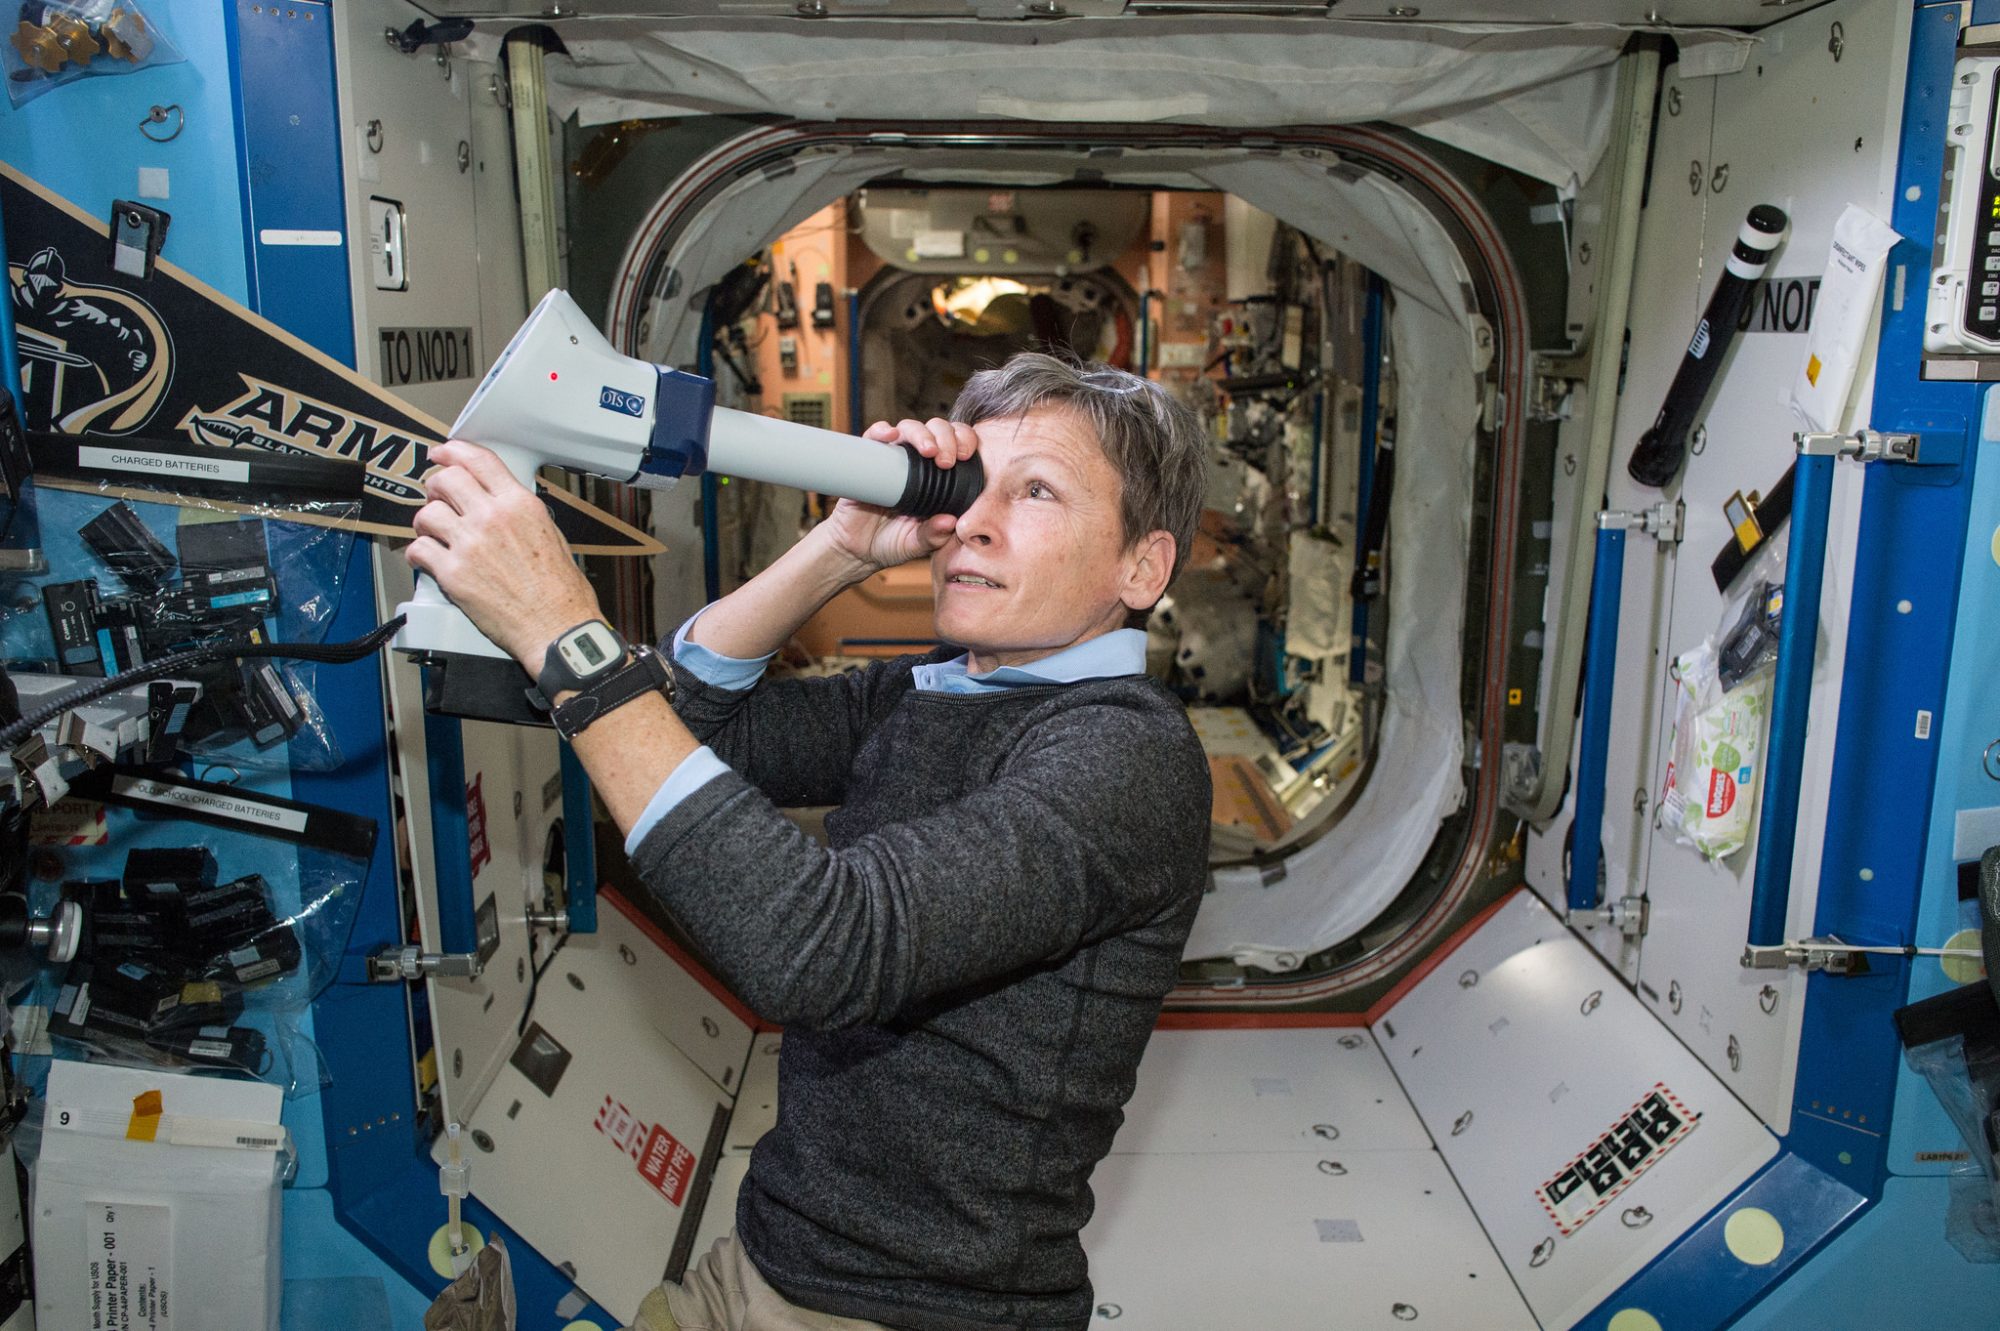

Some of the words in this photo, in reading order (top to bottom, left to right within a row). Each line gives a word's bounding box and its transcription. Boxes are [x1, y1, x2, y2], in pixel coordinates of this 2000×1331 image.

[381, 330, 412, 385] TO
[416, 329, 458, 381] NOD
[462, 331, 471, 378] 1
[226, 385, 440, 481] ARMY
[251, 435, 312, 457] BLAC
[111, 454, 163, 468] CHARGED
[165, 459, 220, 474] BATTERIES
[138, 784, 156, 795] OLD
[156, 787, 193, 803] SCHOOL
[192, 794, 234, 810] CHARGED
[234, 803, 281, 821] BATTERIES
[60, 1111, 70, 1126] 9
[644, 1134, 672, 1178] WATER
[660, 1165, 681, 1200] MIST
[671, 1144, 690, 1172] PFE
[105, 1210, 116, 1223] Qty
[103, 1231, 116, 1250] 001
[90, 1261, 100, 1280] USOS
[105, 1258, 119, 1289] Paper
[91, 1280, 100, 1290] for
[148, 1277, 157, 1298] Paper
[91, 1290, 102, 1311] Supply
[106, 1292, 118, 1327] Printer
[138, 1283, 147, 1317] Contents:
